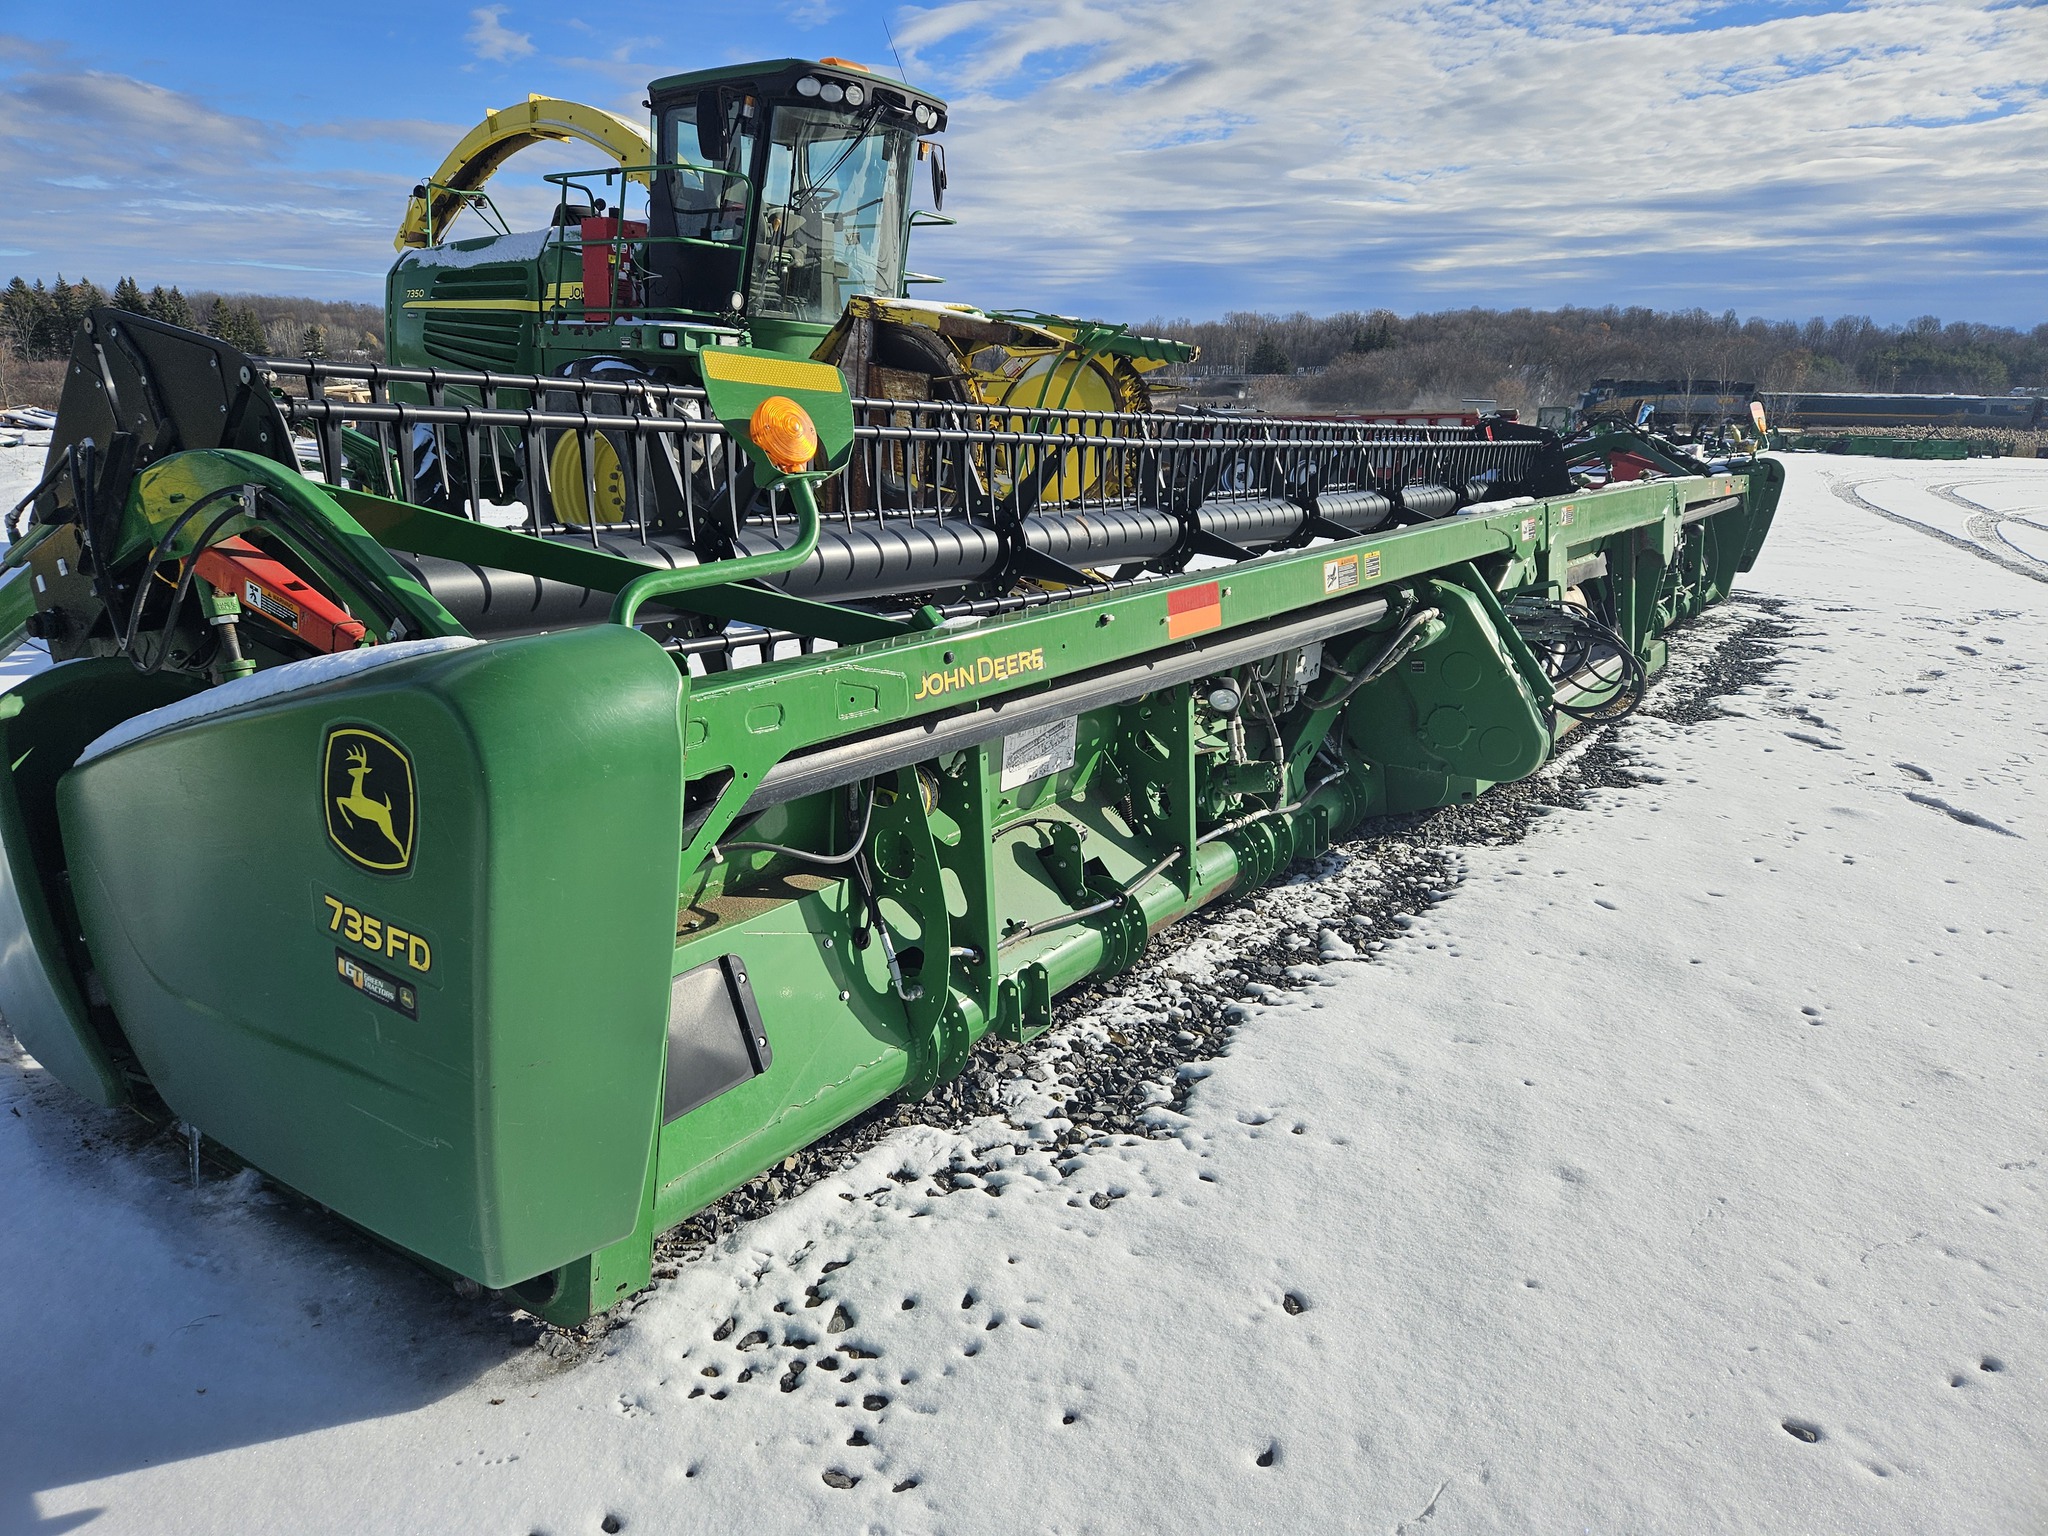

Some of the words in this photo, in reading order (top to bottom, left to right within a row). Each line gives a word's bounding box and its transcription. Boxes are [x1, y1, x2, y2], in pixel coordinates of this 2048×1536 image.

[406, 289, 425, 298] 7350
[914, 664, 976, 700] JOHN
[977, 647, 1043, 683] DEERE
[363, 972, 384, 988] GREEN
[363, 980, 395, 1000] TRACTORS
